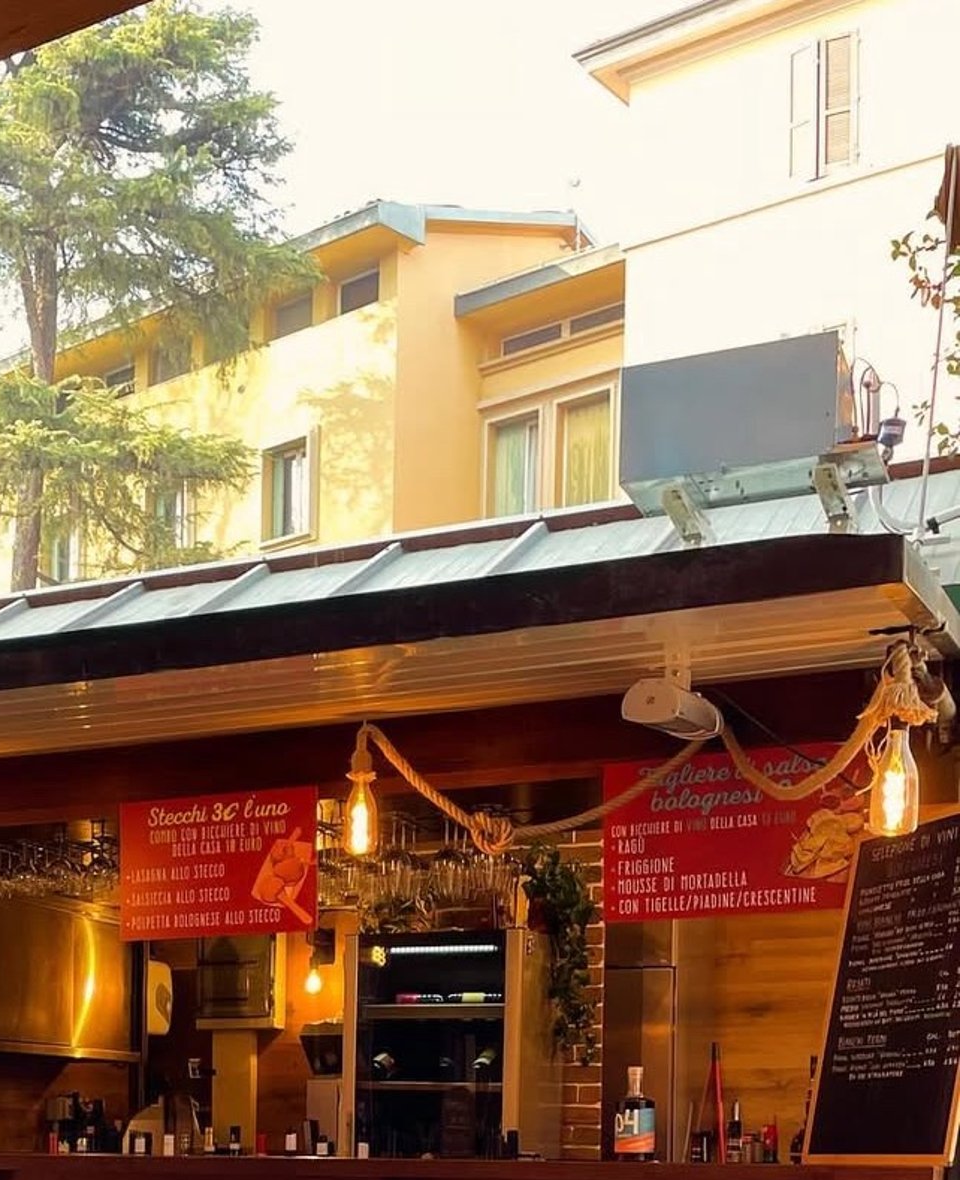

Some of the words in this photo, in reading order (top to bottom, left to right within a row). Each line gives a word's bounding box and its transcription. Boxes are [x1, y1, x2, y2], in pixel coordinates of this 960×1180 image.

[147, 804, 207, 827] Stecchi
[243, 794, 291, 819] l'uno
[651, 787, 763, 815] bolognesi
[181, 827, 199, 842] CON
[250, 822, 260, 837] DI
[263, 819, 287, 834] VINO
[709, 814, 735, 830] DELLA
[737, 813, 759, 828] CASA
[172, 843, 197, 858] DELLA
[200, 841, 221, 856] CASA
[240, 836, 263, 852] EURO
[618, 837, 646, 855] RAGÙ
[131, 867, 167, 884] LASAGNA
[171, 865, 189, 881] ALLO
[193, 863, 226, 879] STECCO
[618, 857, 675, 876] FRIGGIONE
[618, 876, 657, 896] MOUSSE
[664, 875, 675, 892] DI
[680, 870, 748, 891] MORTADELLA
[132, 890, 172, 907] SALSICCIA
[176, 888, 196, 904] ALLO
[198, 886, 231, 903] STECCO
[618, 898, 639, 915] CON
[131, 914, 170, 931] POLPETTA
[174, 911, 220, 929] BOLOGNESE
[224, 909, 245, 925] ALLO
[249, 907, 282, 924] STECCO
